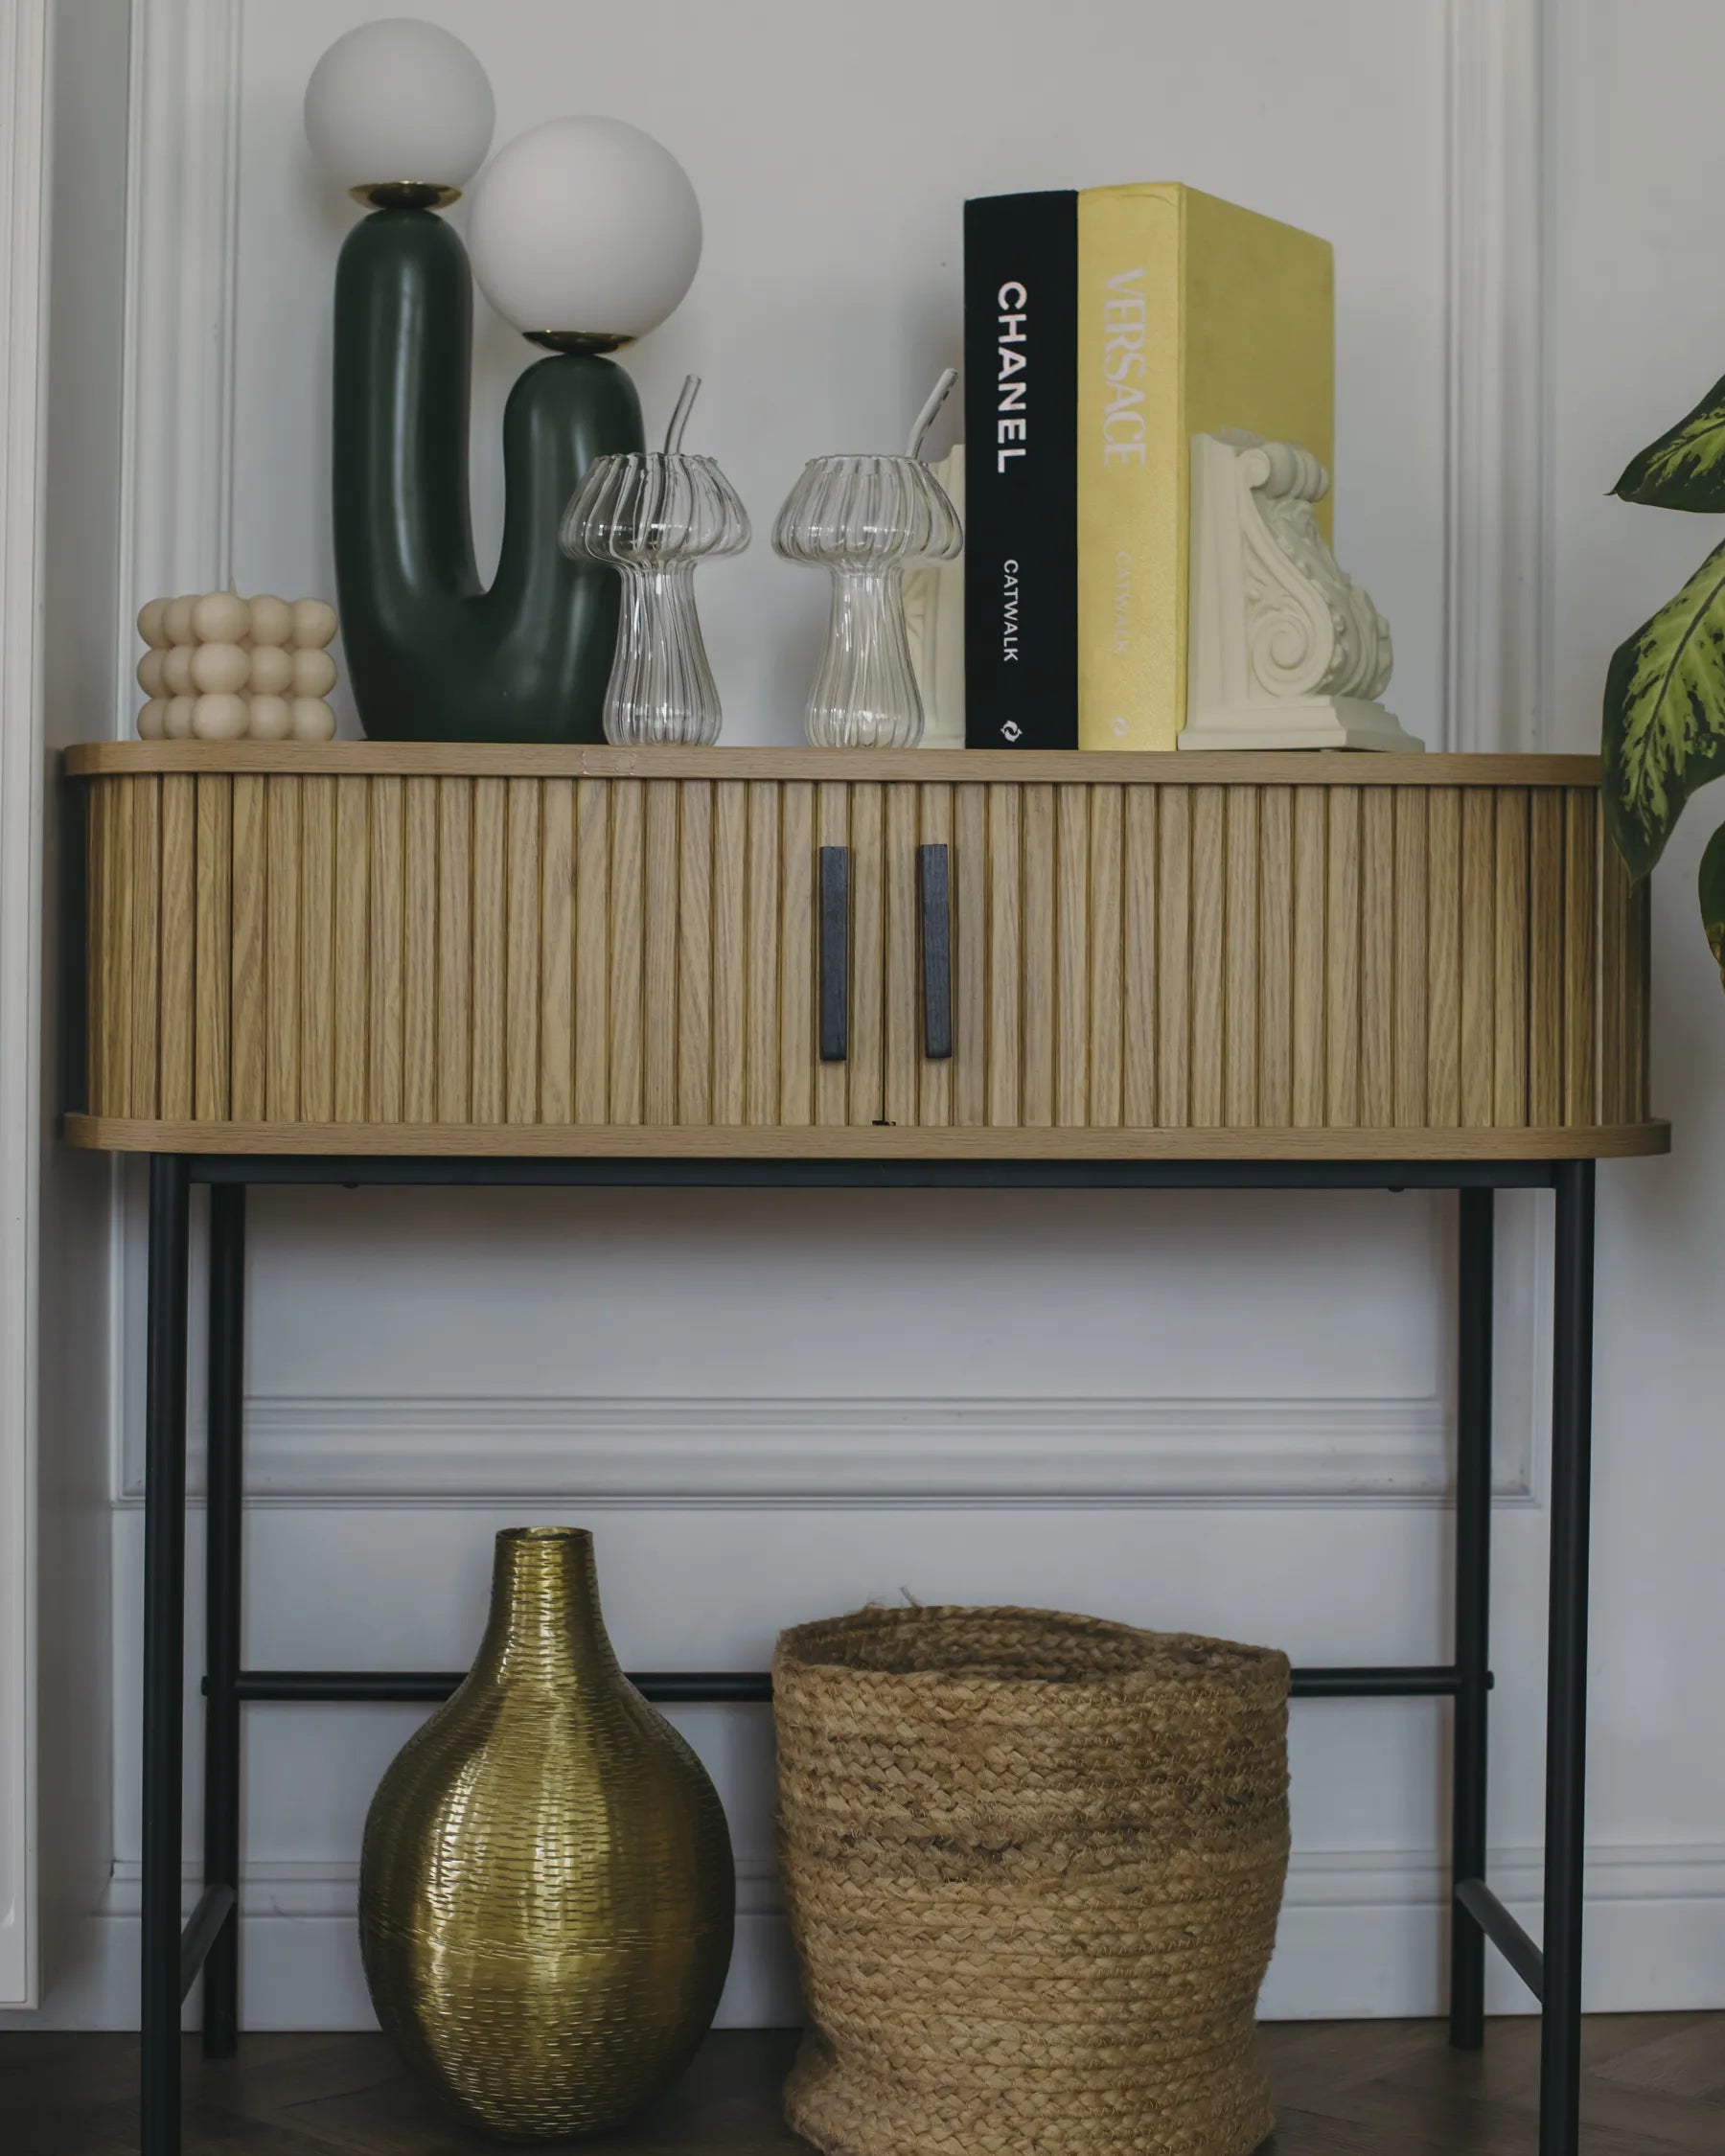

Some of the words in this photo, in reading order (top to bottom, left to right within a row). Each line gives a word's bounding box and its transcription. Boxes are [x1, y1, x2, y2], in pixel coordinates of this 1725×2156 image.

[998, 281, 1027, 473] CHANEL
[1103, 266, 1146, 467] VERSACE
[1003, 559, 1019, 662] CATWALK
[1114, 550, 1131, 655] CATWALK
